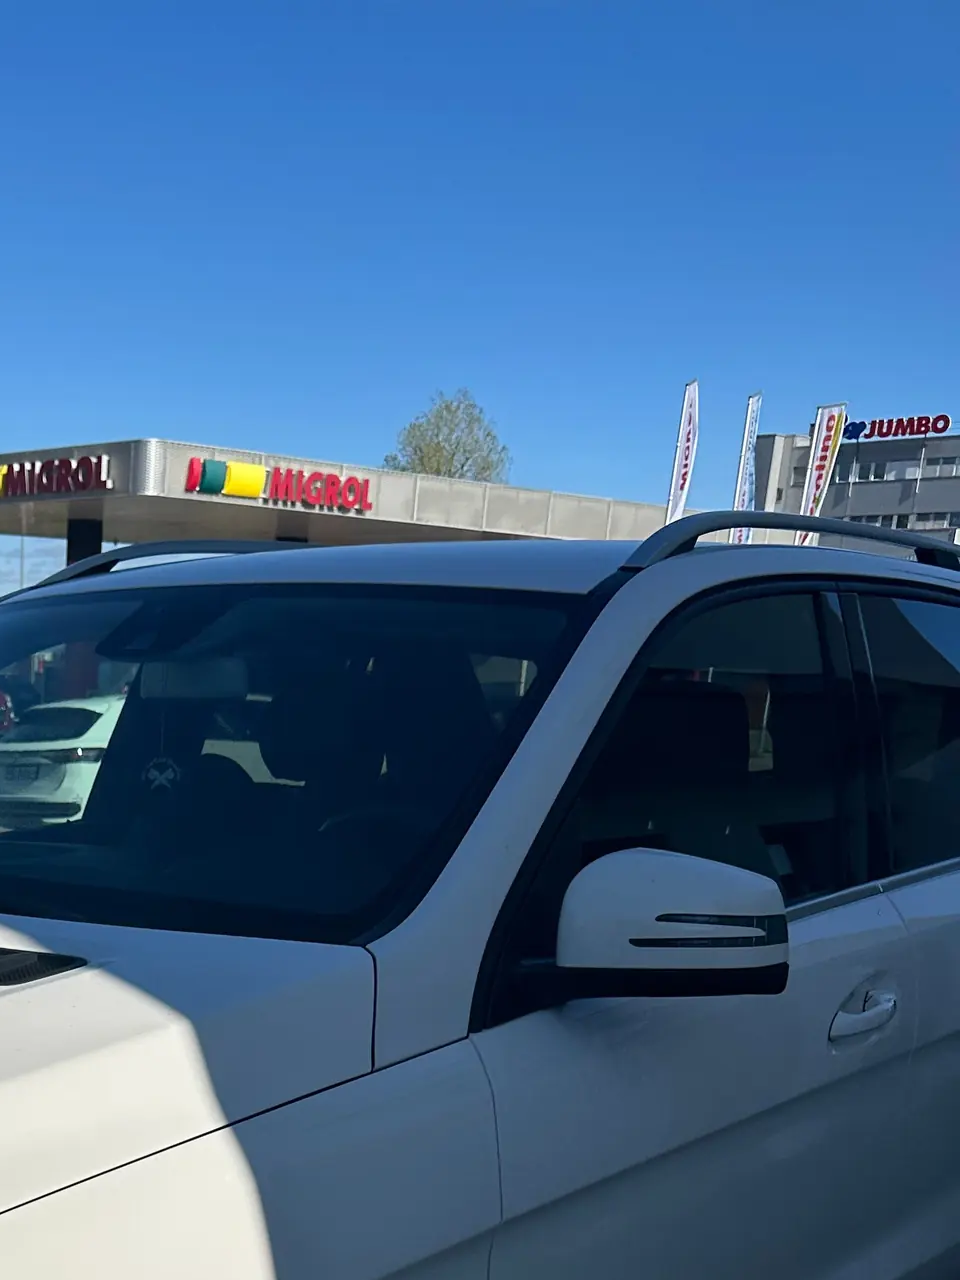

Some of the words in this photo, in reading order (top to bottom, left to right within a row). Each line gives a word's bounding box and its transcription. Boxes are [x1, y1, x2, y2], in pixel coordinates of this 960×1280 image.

[864, 414, 951, 438] JUMBO
[5, 455, 113, 496] MIGROL
[269, 467, 372, 511] MIGROL
